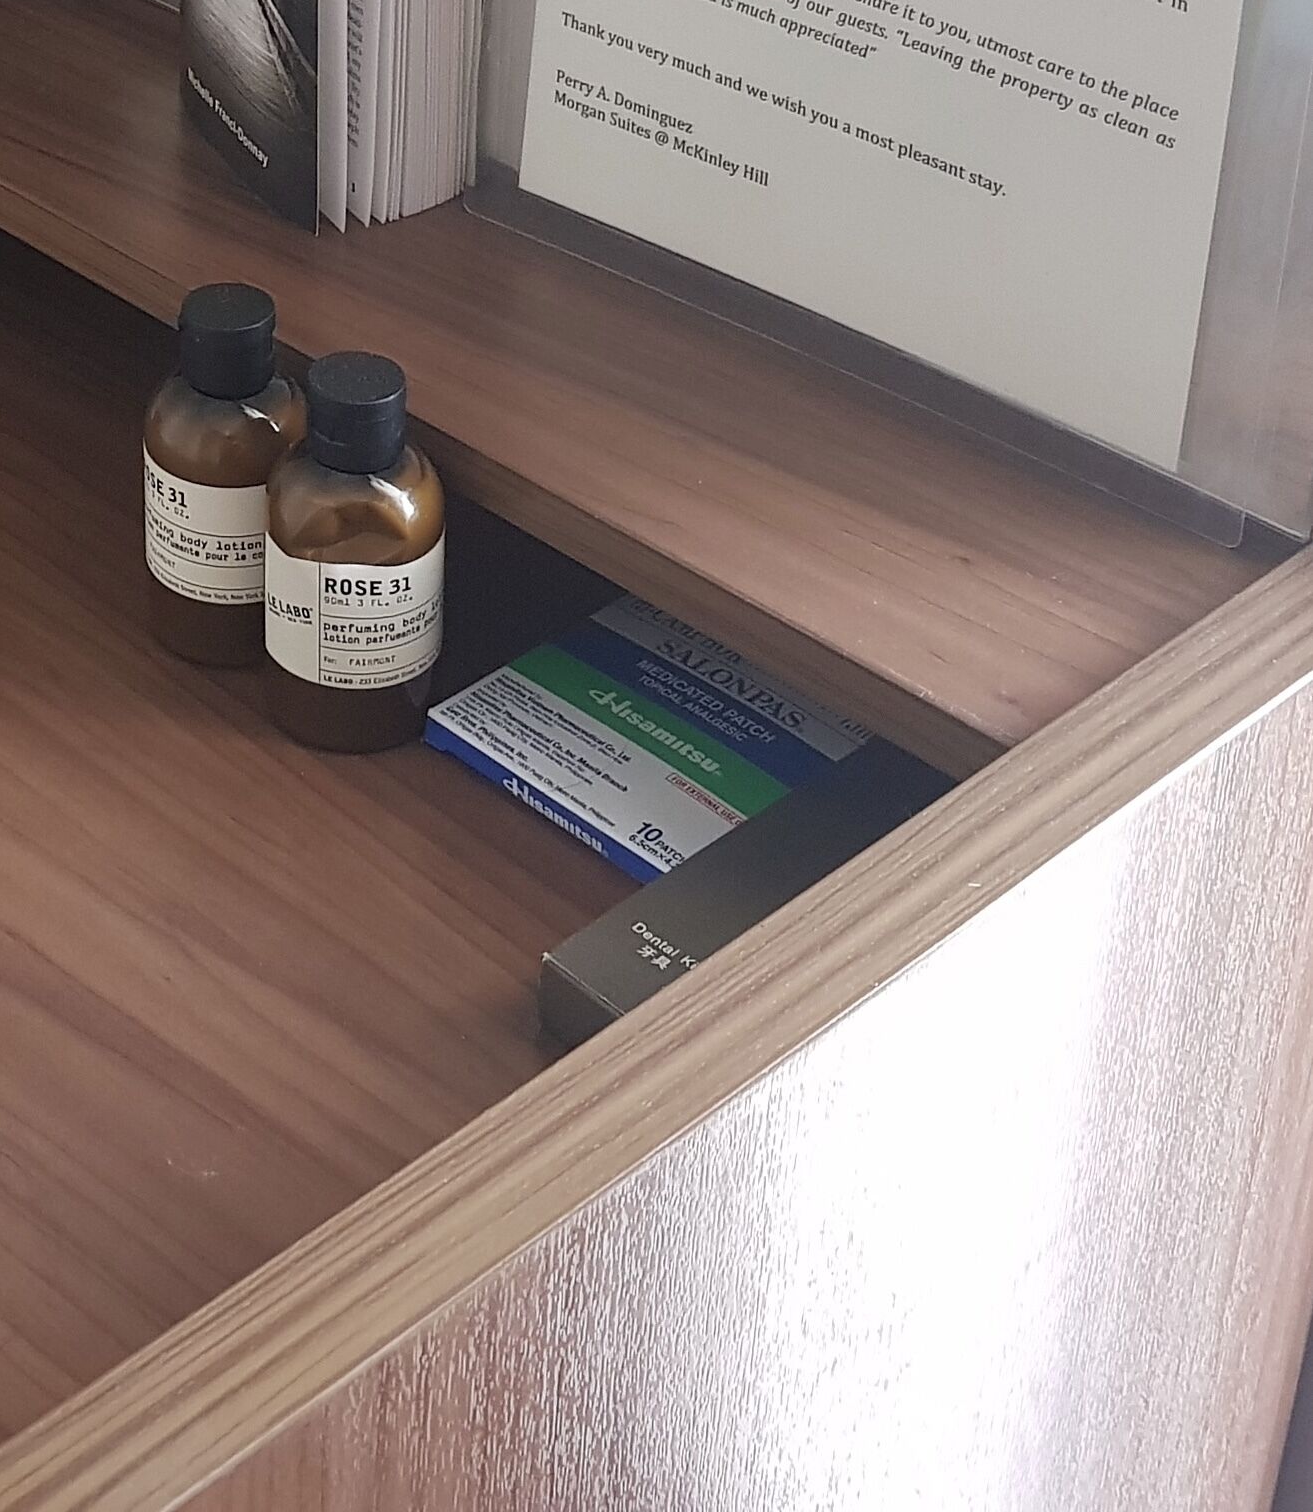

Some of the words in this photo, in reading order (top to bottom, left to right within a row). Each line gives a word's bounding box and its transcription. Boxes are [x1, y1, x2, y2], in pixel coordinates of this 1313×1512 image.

[555, 68, 595, 98] Perry
[594, 84, 611, 103] A.
[613, 89, 694, 135] Dominguez
[560, 10, 606, 41] Thank
[605, 31, 634, 52] you
[636, 41, 670, 67] very
[670, 55, 712, 81] much
[713, 72, 743, 93] and
[745, 83, 769, 102] we
[770, 92, 807, 118] wish
[807, 108, 839, 130] you
[841, 121, 852, 135] a
[854, 126, 896, 152] most
[896, 142, 967, 181] pleasant
[967, 171, 1007, 197] stay.
[553, 88, 607, 123] Morgan
[608, 110, 652, 140] Suites
[653, 129, 670, 147] @
[671, 135, 741, 178] McKinley
[742, 162, 770, 187] Hill
[167, 486, 188, 508] 31
[180, 531, 208, 549] body
[215, 540, 263, 552] lotion
[205, 551, 229, 562] pour
[234, 551, 247, 561] le
[323, 576, 384, 597] ROSE
[388, 575, 413, 596] 31
[278, 599, 312, 620] LABO
[356, 599, 365, 608] 3
[371, 598, 391, 608] FL.
[323, 620, 396, 635] perfuming
[402, 609, 427, 628] body
[323, 633, 360, 646] lotion
[655, 638, 807, 730] SALONPAS
[636, 658, 725, 712] MEDICATED
[721, 705, 777, 744] PATCH
[637, 673, 683, 705] TOPICAL
[684, 698, 749, 743] ANALGESIC
[588, 688, 721, 774] Hisamitsu
[502, 777, 605, 854] Hisamitsu
[635, 821, 663, 843] 10
[631, 921, 681, 957] Dental
